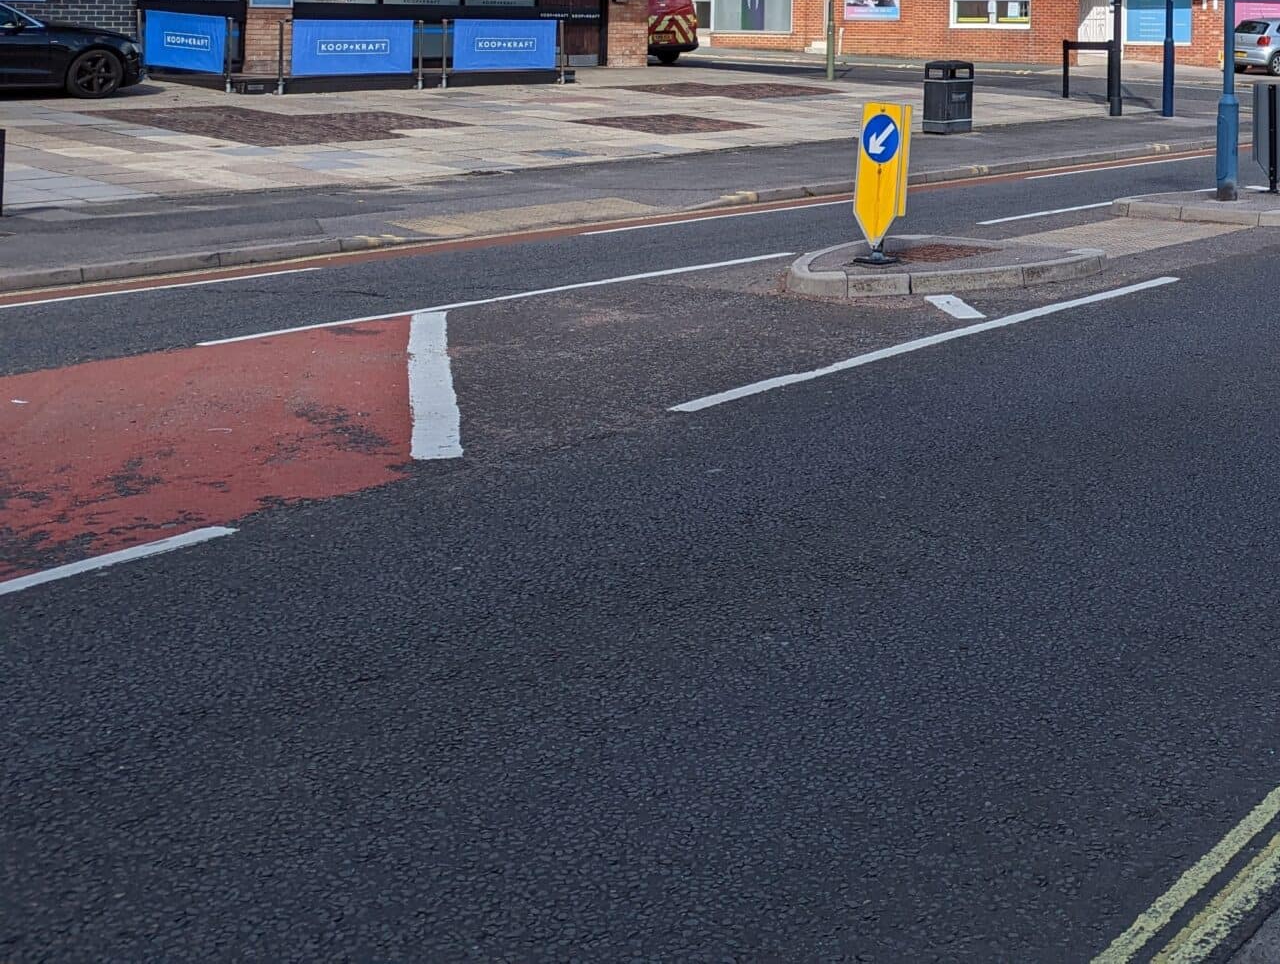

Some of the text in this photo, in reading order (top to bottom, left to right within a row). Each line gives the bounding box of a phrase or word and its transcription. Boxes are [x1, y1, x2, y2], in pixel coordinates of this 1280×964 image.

[166, 36, 209, 46] KOOP+KRAFT
[478, 40, 535, 49] KOOP+KRAFT
[320, 43, 387, 51] KOOP+KRAFT
